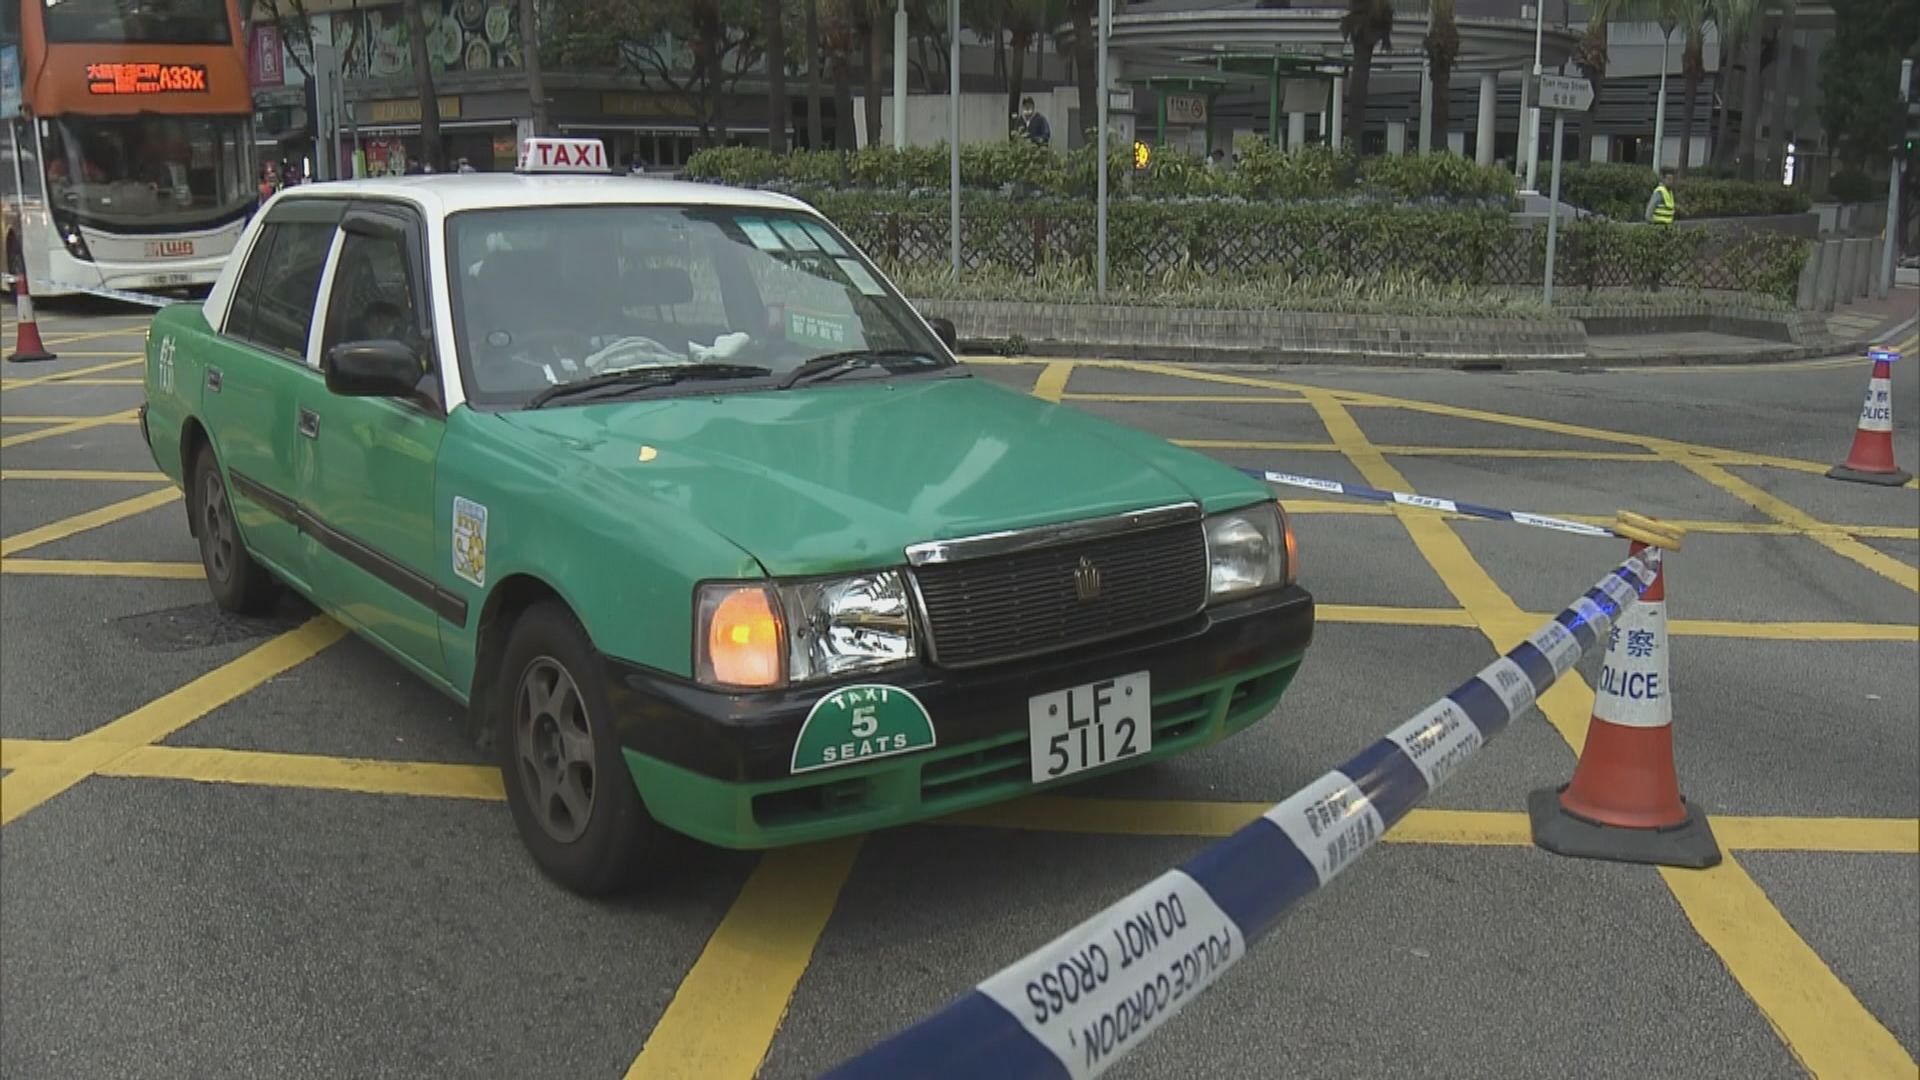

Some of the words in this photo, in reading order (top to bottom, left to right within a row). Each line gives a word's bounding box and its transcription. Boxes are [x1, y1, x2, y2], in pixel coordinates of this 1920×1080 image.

[536, 143, 601, 167] TAXI
[830, 688, 888, 710] TAXI
[1067, 680, 1115, 730] LF
[1600, 665, 1658, 699] OLICE
[851, 706, 879, 738] 5
[823, 733, 907, 762] SEATS
[1048, 717, 1137, 775] 5112
[1155, 892, 1188, 938] DO
[1113, 910, 1160, 968] NOT
[1025, 943, 1110, 1025] CROSS
[1171, 925, 1232, 1001] POLICE
